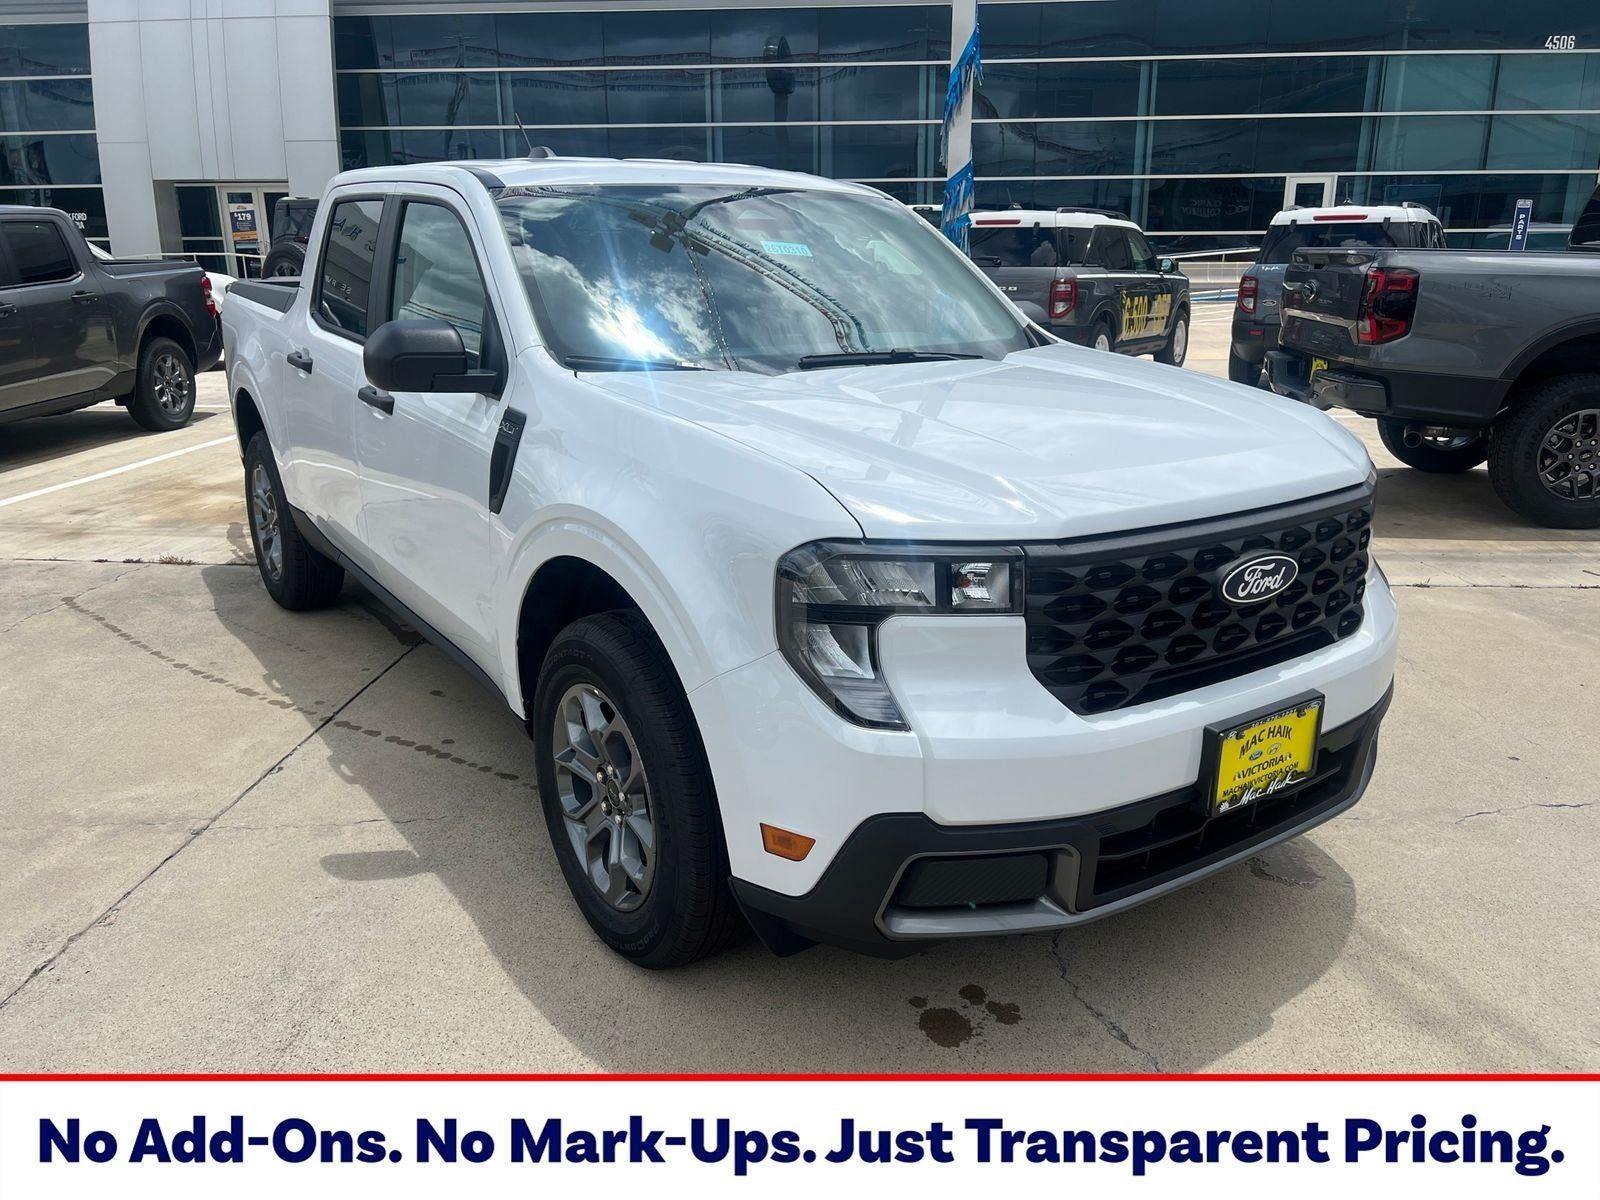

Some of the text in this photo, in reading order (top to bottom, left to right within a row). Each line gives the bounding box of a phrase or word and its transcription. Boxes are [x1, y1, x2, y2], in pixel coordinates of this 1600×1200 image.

[1544, 35, 1576, 50] 4506
[71, 212, 88, 221] FORD
[233, 212, 252, 221] $179
[1515, 213, 1526, 240] PARTS
[500, 420, 519, 435] XLT
[1237, 562, 1286, 598] Ford
[1239, 729, 1265, 759] MAC
[1267, 725, 1292, 740] HAIK
[1223, 761, 1299, 796] MACHAIKVICTORIA.COM
[1241, 754, 1285, 779] VICTORIA
[1239, 770, 1303, 806] Mac Haik
